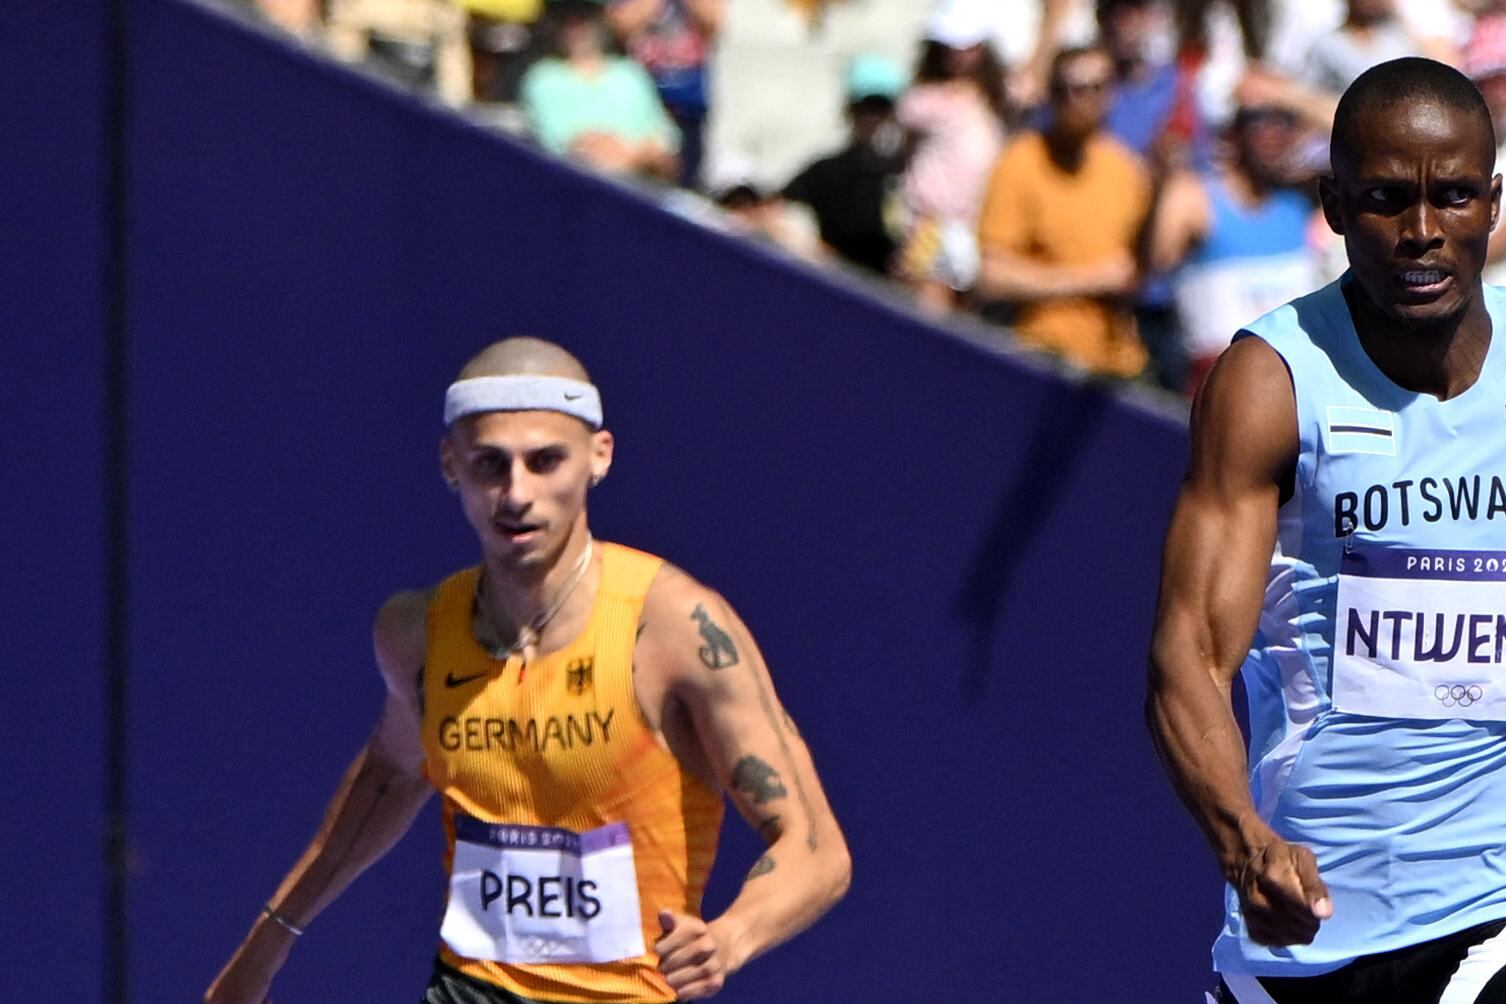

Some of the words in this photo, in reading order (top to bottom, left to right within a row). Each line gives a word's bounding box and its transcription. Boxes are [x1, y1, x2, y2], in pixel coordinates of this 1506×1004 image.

[1406, 556, 1466, 573] PARIS
[440, 710, 615, 752] GERMANY
[480, 870, 602, 919] PREIS
